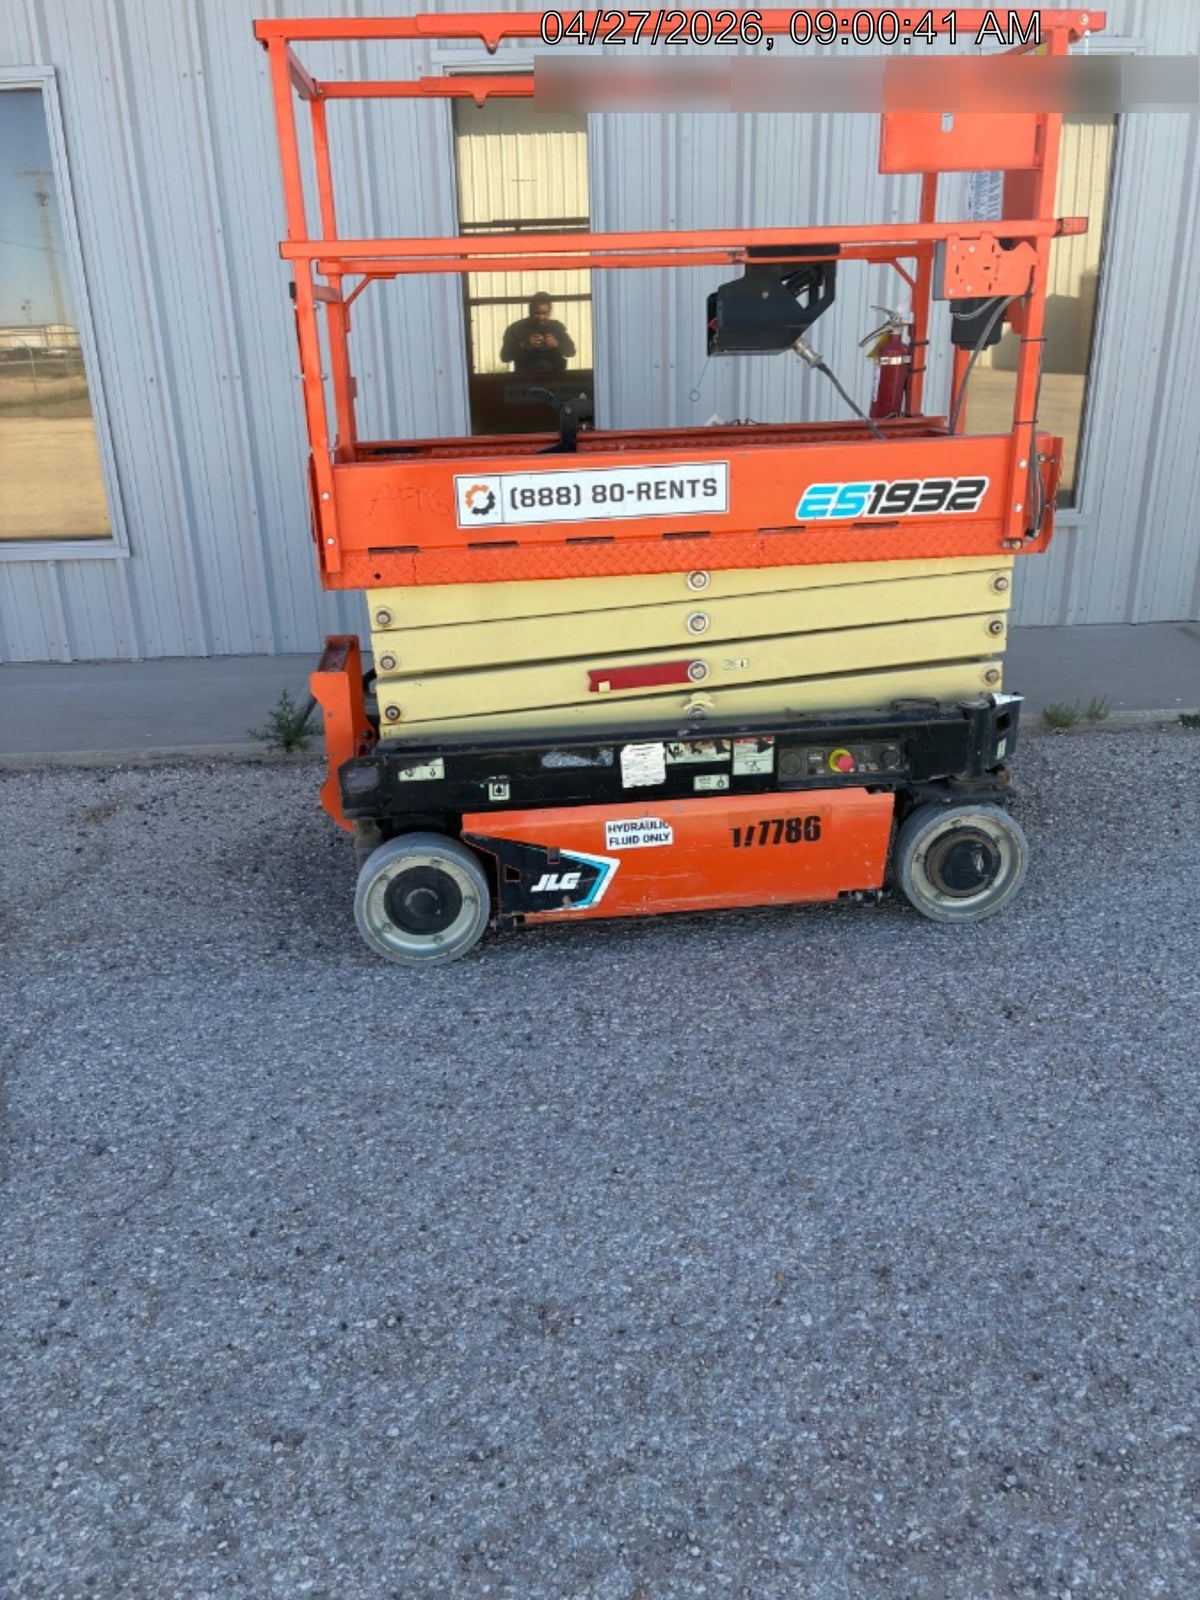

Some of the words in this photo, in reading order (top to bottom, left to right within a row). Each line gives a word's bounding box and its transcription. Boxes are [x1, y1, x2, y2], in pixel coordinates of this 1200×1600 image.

[510, 484, 582, 510] (888)
[591, 478, 718, 503] 80-RENTS
[796, 477, 989, 520] ES1932
[609, 835, 640, 846] FLUID
[643, 832, 671, 843] ONLY
[529, 872, 582, 893] JLG
